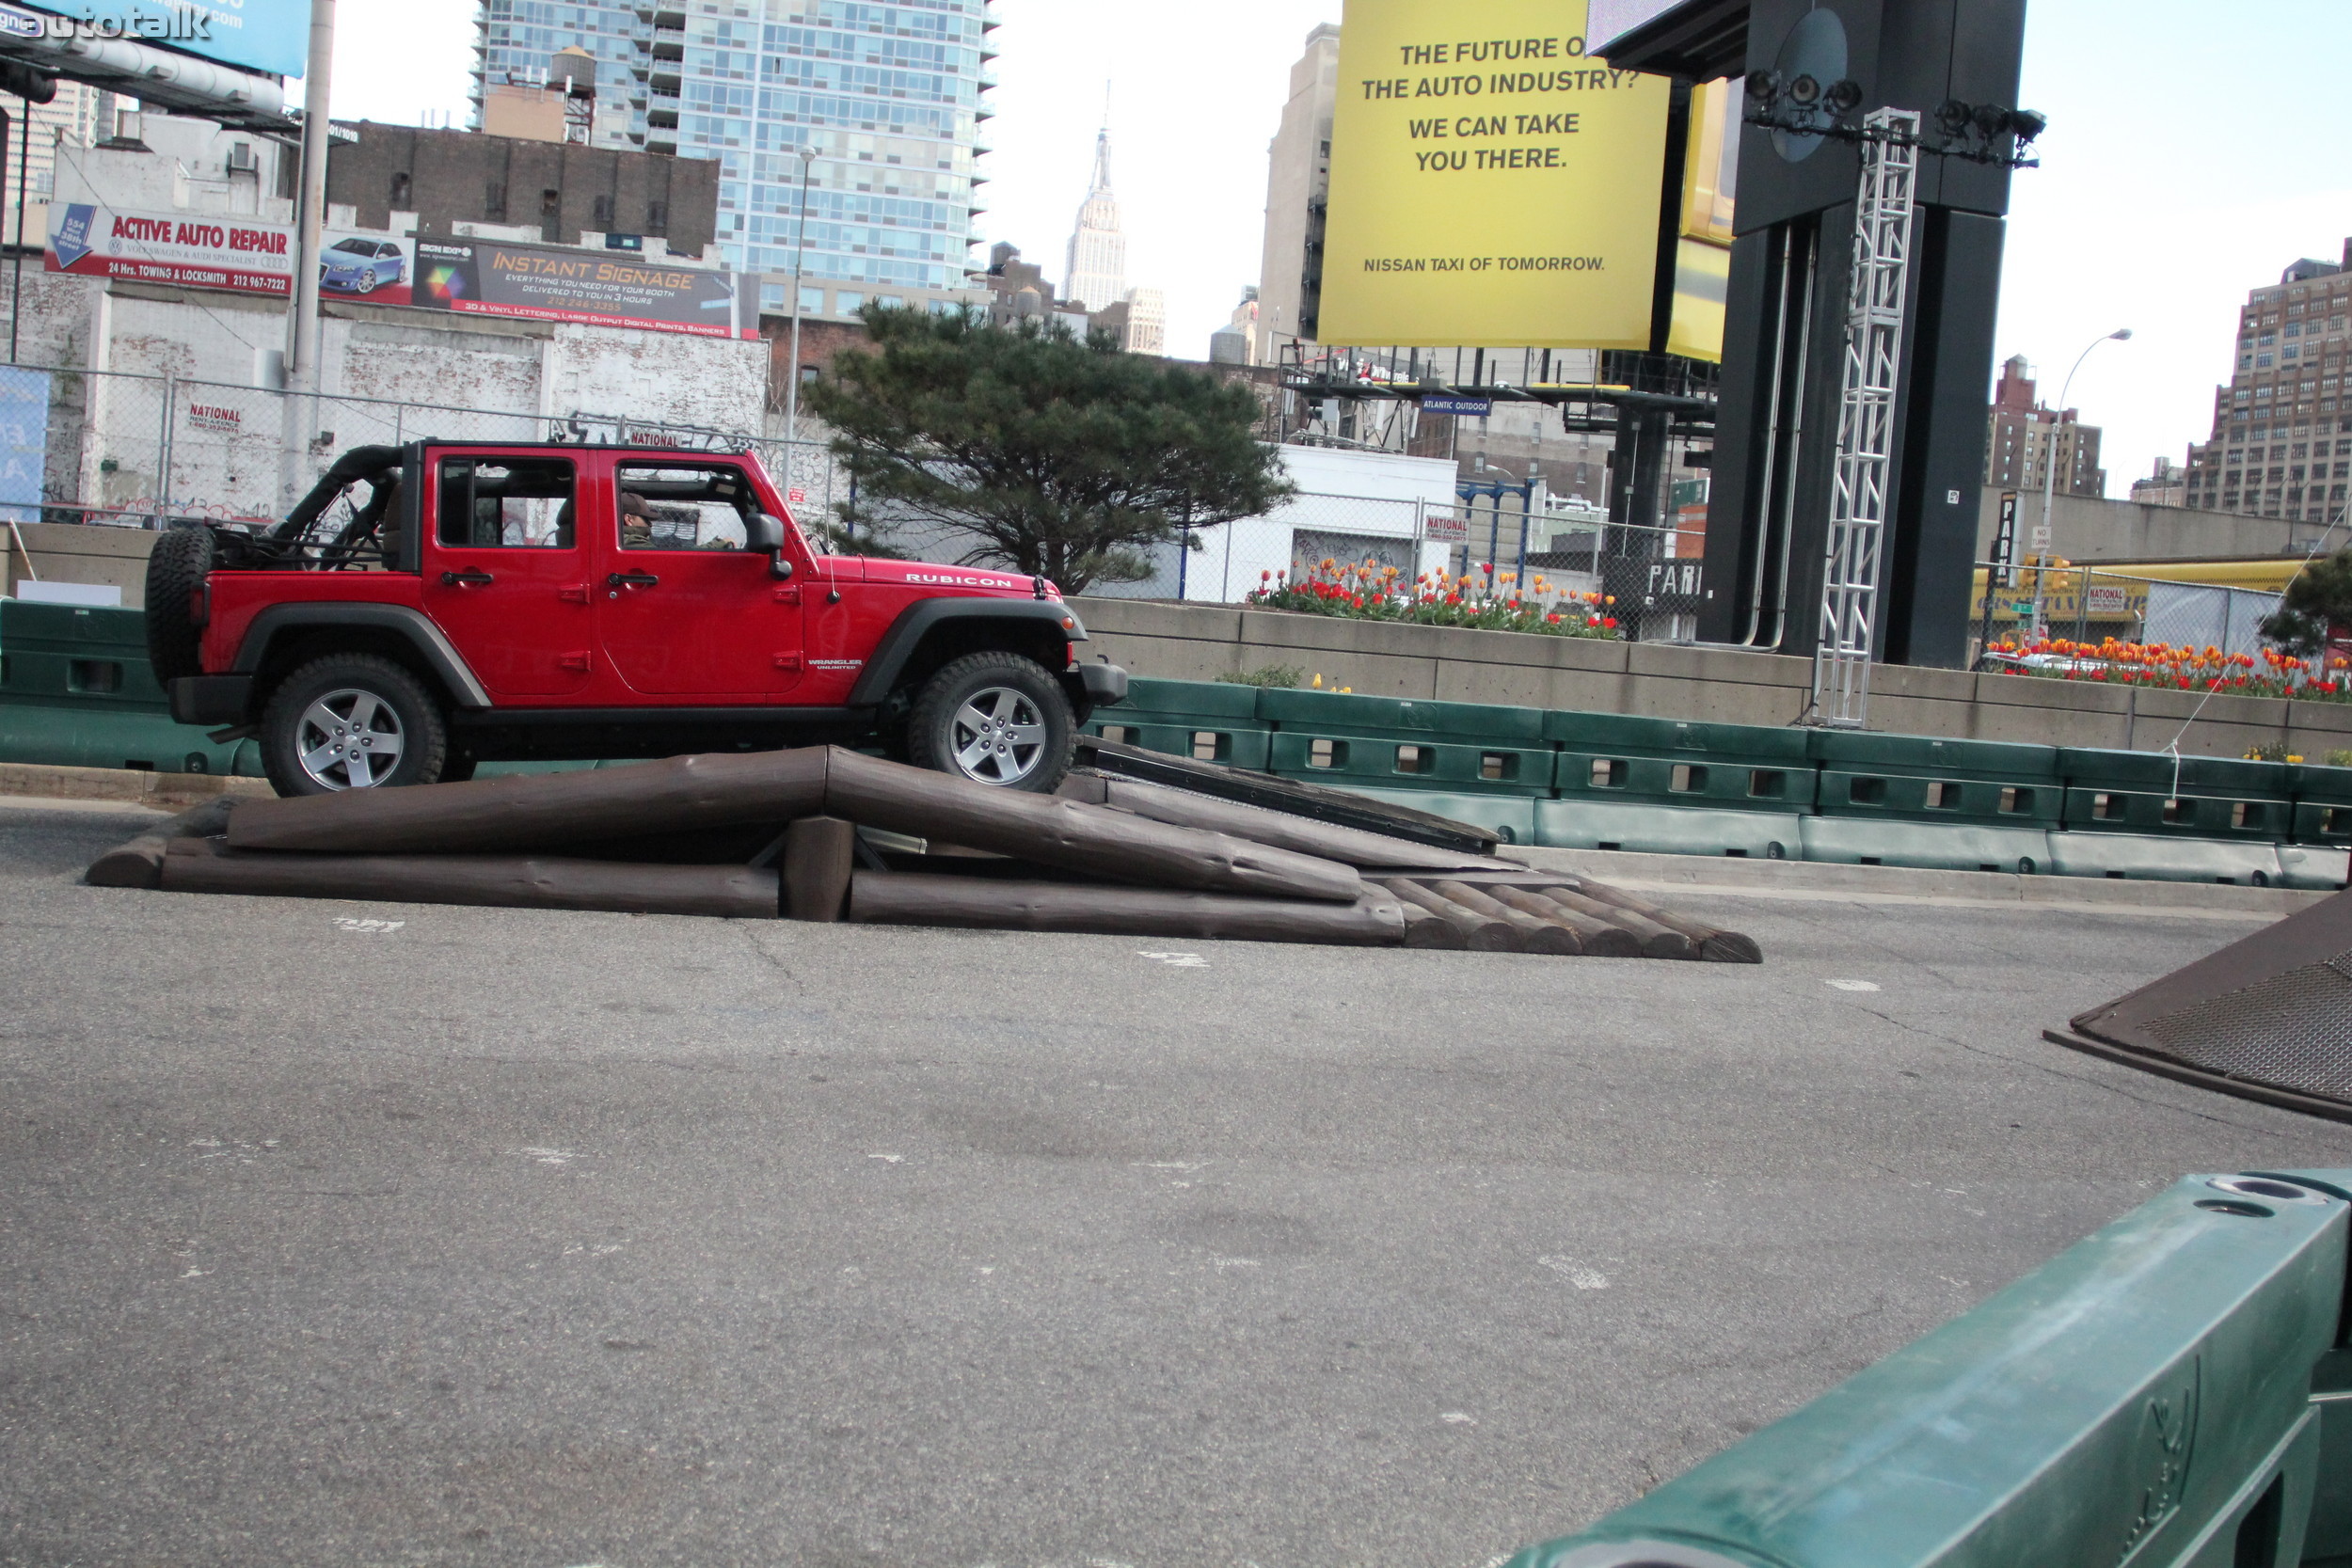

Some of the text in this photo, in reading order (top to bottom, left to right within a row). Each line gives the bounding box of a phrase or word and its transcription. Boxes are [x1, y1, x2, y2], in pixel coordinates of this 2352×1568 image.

[1401, 44, 1449, 65] THE
[1455, 38, 1558, 62] FUTURE
[1362, 69, 1640, 99] THE AUTO INDUSTRY?
[1409, 113, 1580, 138] WE CAN TAKE
[1416, 148, 1567, 171] YOU THERE.
[111, 215, 287, 255] ACTIVE AUTO REPAIR
[127, 245, 183, 258] VOLKSWAGEN
[192, 252, 212, 261] AUDI
[213, 254, 256, 265] SPECIALIST
[1364, 257, 1605, 272] NISSAN TAXI OF TOMORROW.
[108, 261, 286, 290] 24 Hrs. TOWING & LOCKSMITH 212 967-7222
[493, 252, 591, 277] INSTANT
[596, 263, 695, 290] SIGNAGE
[505, 274, 559, 285] EVERYTHING
[561, 279, 578, 288] YOU
[579, 282, 602, 291] NEED
[622, 286, 644, 294] YOUR
[645, 289, 675, 298] BOOTH
[522, 285, 570, 296] DELIVERED
[623, 296, 653, 305] HOURS
[190, 404, 241, 422] NATIONAL
[1423, 400, 1487, 411] ATLANTIC OUTDOOR
[631, 432, 678, 448] NATIONAL
[1427, 517, 1468, 531] NATIONAL
[1998, 501, 2012, 576] PARK
[906, 573, 1012, 588] RUBICON
[2090, 589, 2122, 599] NATIONAL
